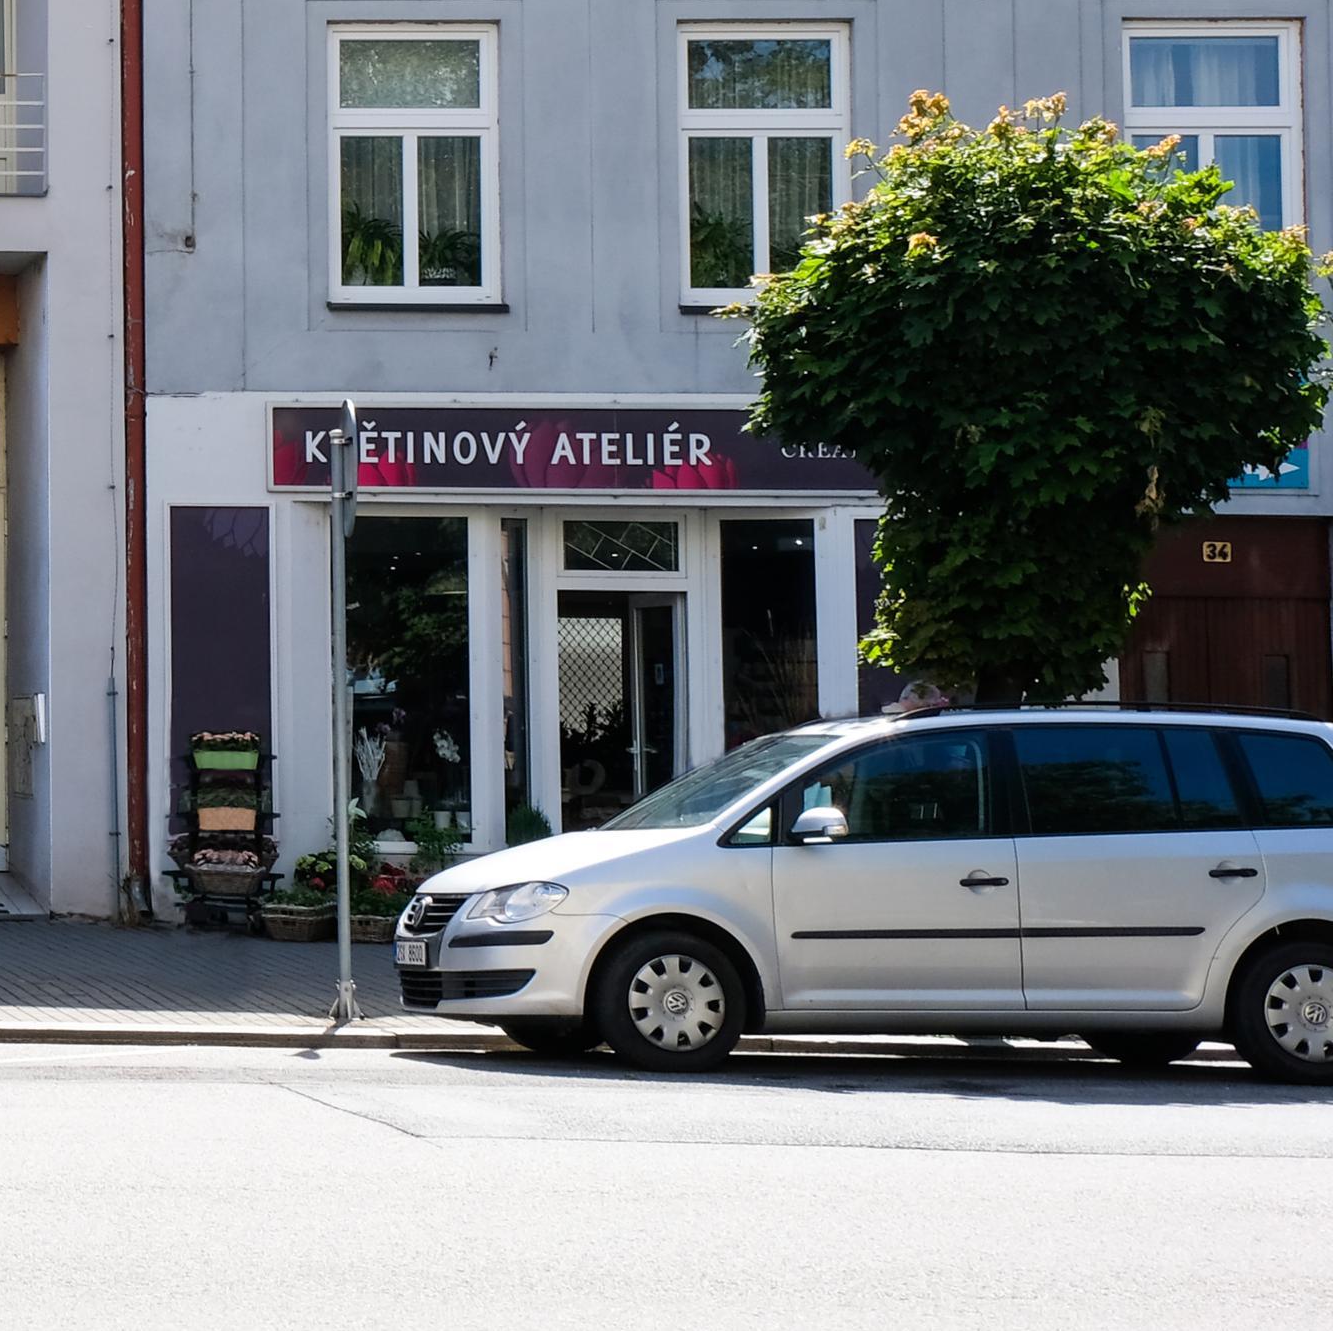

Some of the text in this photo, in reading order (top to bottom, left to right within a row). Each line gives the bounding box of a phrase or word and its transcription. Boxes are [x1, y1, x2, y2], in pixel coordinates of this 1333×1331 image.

[305, 421, 713, 466] KĚTINOVÝ ATELIÉR
[1203, 542, 1230, 563] 34
